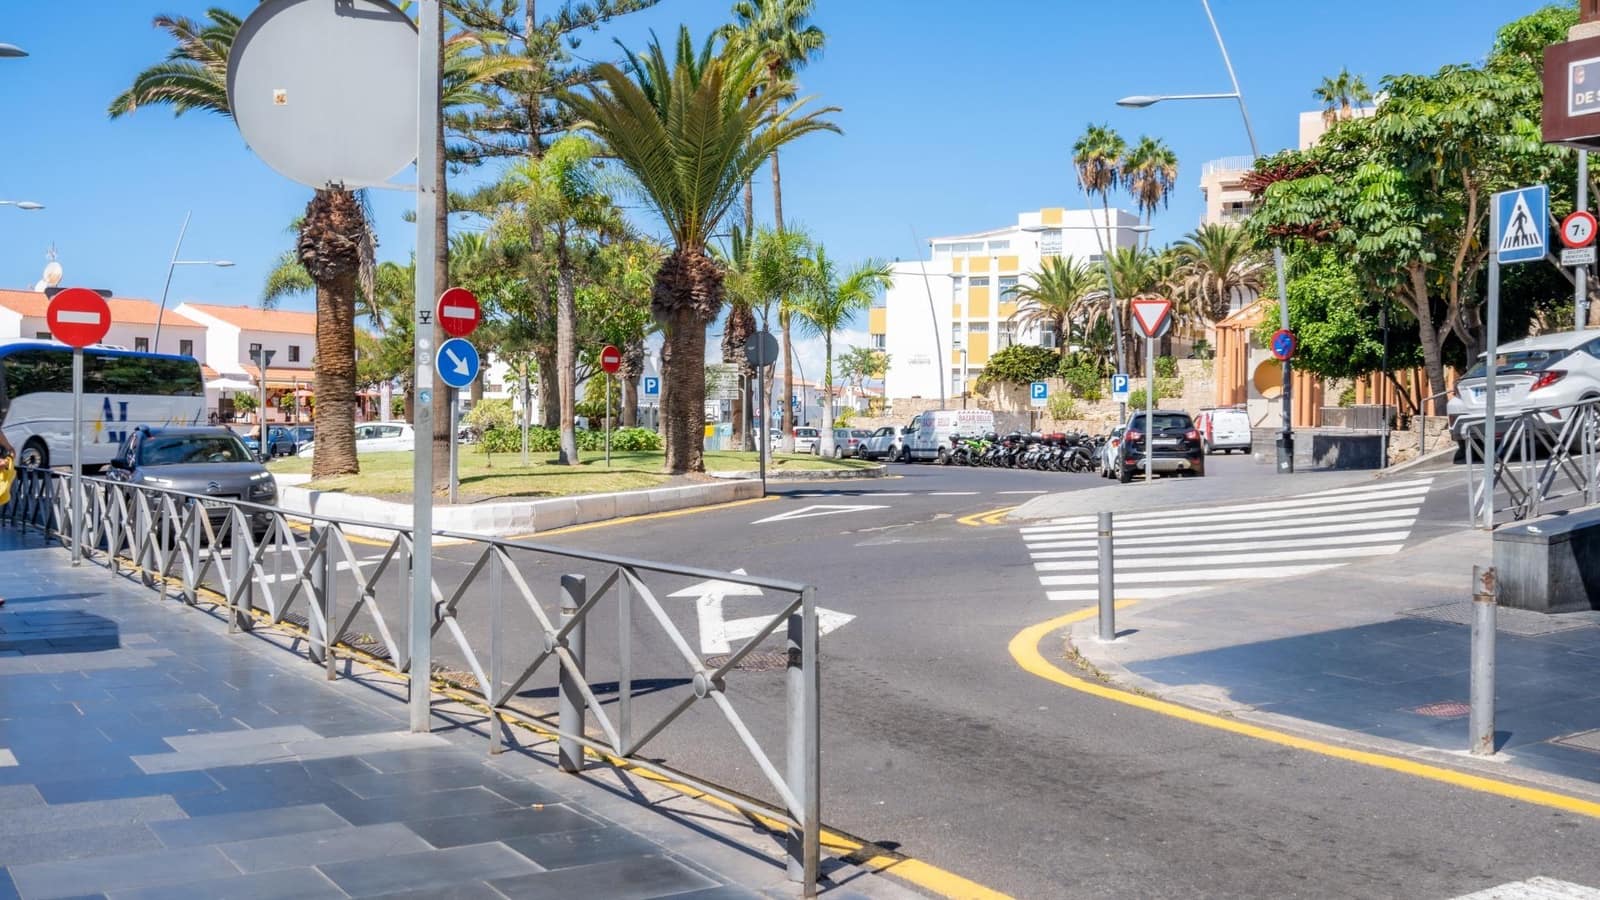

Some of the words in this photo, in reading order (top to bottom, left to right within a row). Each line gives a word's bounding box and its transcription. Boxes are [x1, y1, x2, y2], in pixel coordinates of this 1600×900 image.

[1575, 91, 1594, 104] DE
[647, 379, 656, 392] P
[1115, 377, 1125, 391] P
[1034, 385, 1044, 397] P
